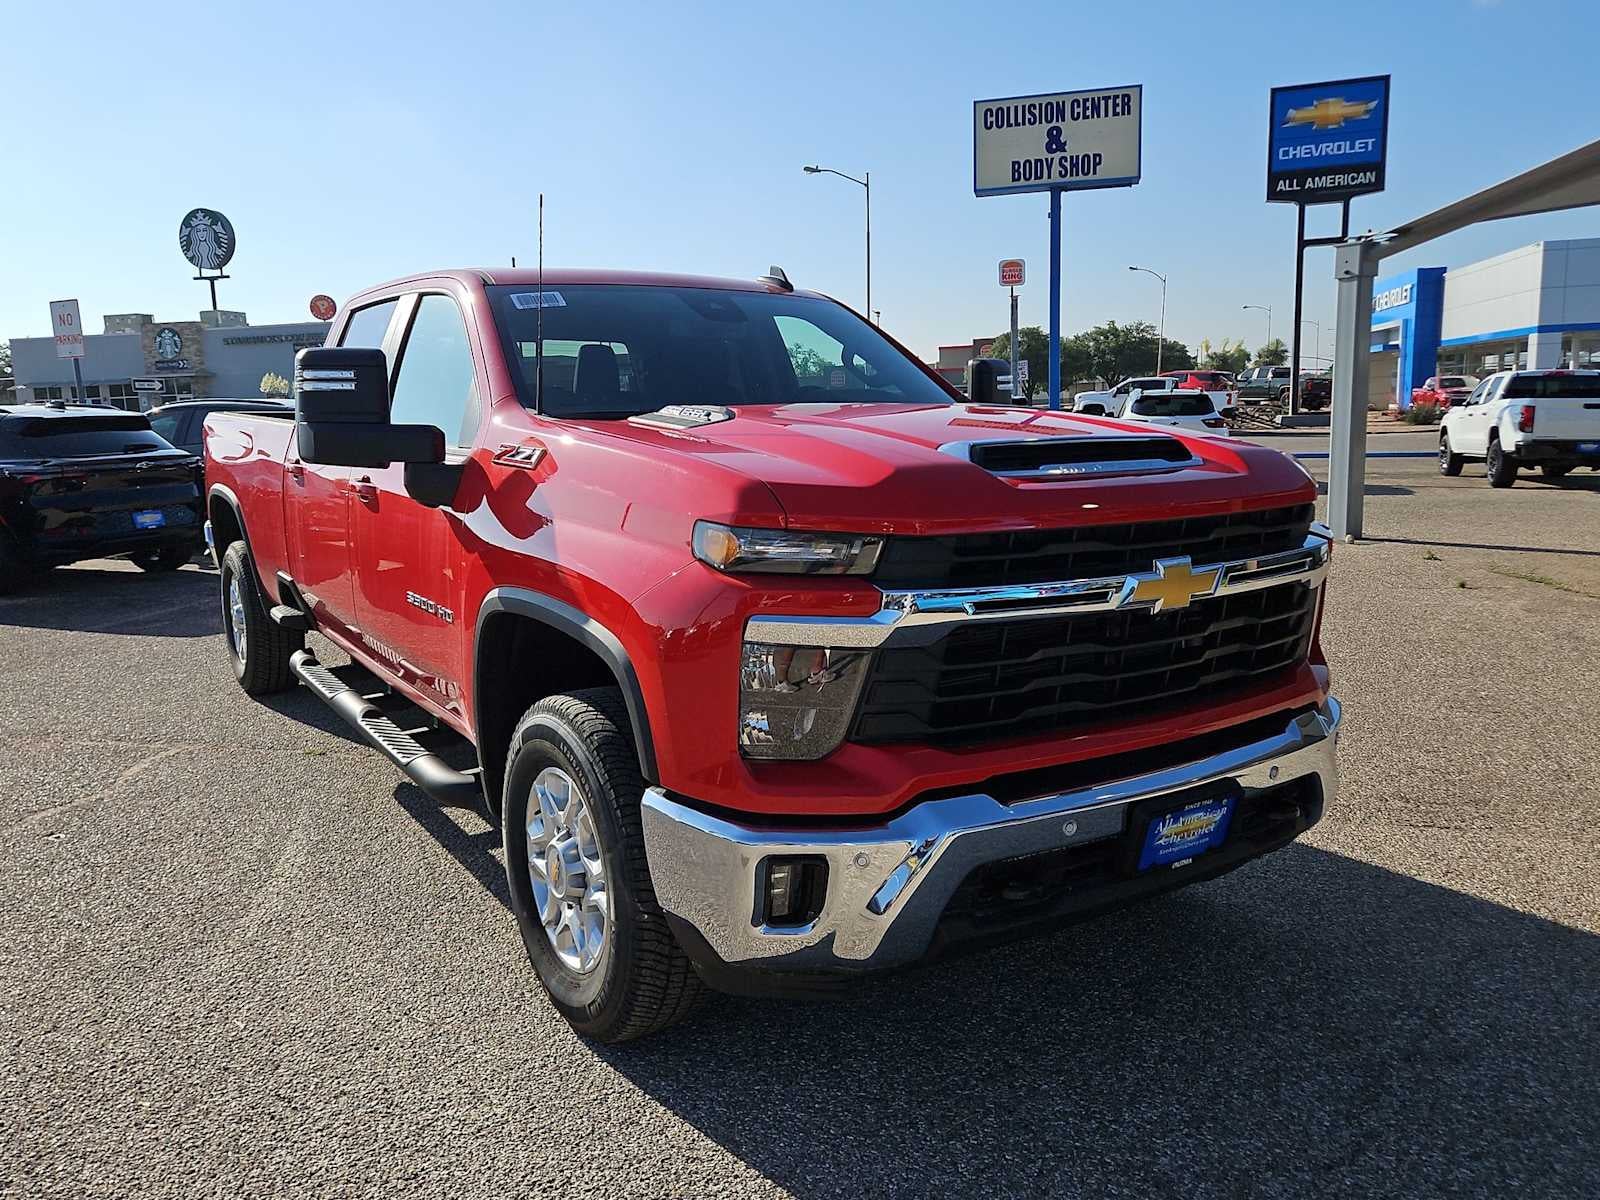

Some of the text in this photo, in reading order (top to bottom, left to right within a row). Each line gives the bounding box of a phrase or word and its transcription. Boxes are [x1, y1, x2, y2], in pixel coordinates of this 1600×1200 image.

[984, 94, 1131, 130] COLLISION CENTER
[1045, 126, 1067, 154] &
[1278, 138, 1376, 160] CHEVROLET
[1011, 153, 1103, 182] BODY SHOP
[1276, 171, 1376, 192] ALL AMERICAN
[1002, 272, 1023, 281] KING
[1376, 283, 1412, 312] CHEVROLET
[58, 313, 73, 327] NO
